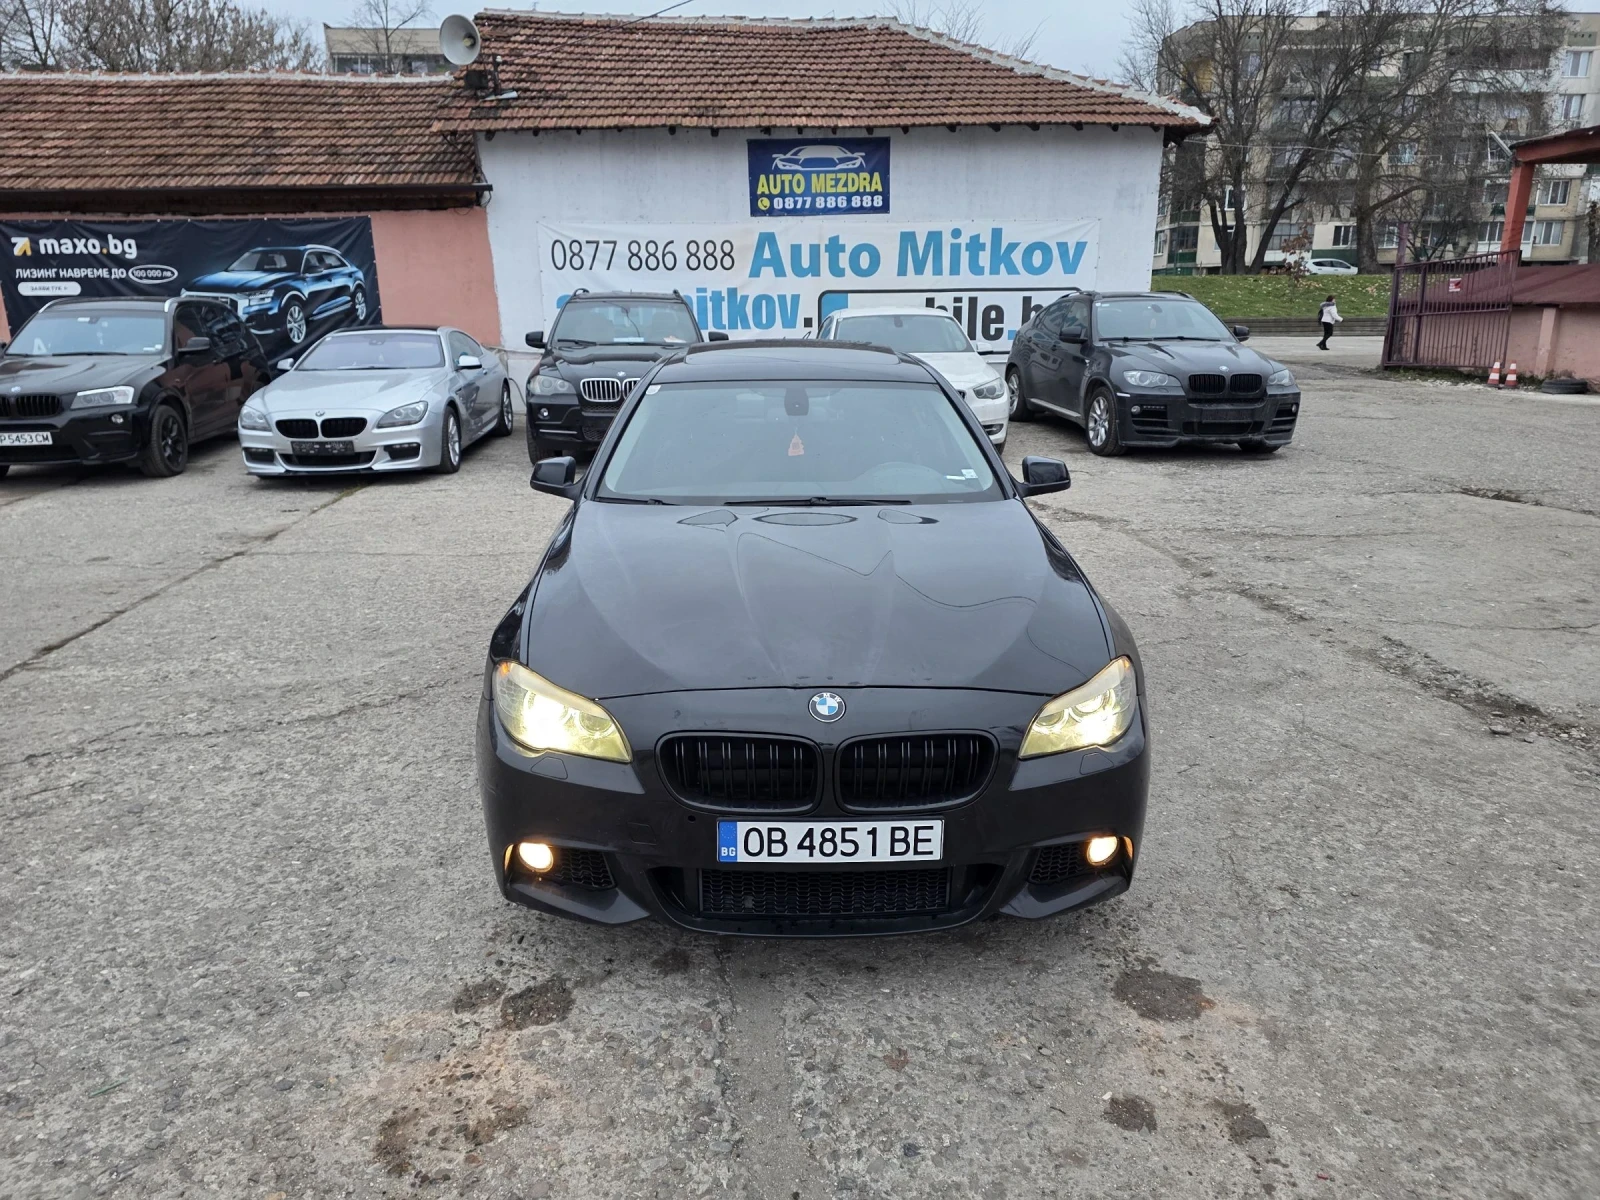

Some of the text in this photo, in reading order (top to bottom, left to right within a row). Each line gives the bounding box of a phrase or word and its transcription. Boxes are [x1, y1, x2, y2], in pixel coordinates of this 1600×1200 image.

[756, 172, 883, 195] AUTO MEZDRA
[773, 195, 883, 210] 0877 886 888
[38, 233, 138, 260] maxo.bg
[551, 239, 735, 271] 0877 886 888
[748, 227, 1088, 278] Auto Mitkov
[15, 268, 57, 279] ЛИЗИНГ
[59, 268, 110, 279] НАВРЕМЕ
[111, 268, 127, 280] ДО
[147, 269, 162, 278] 000
[720, 825, 935, 858] BG OB 4851 BE
